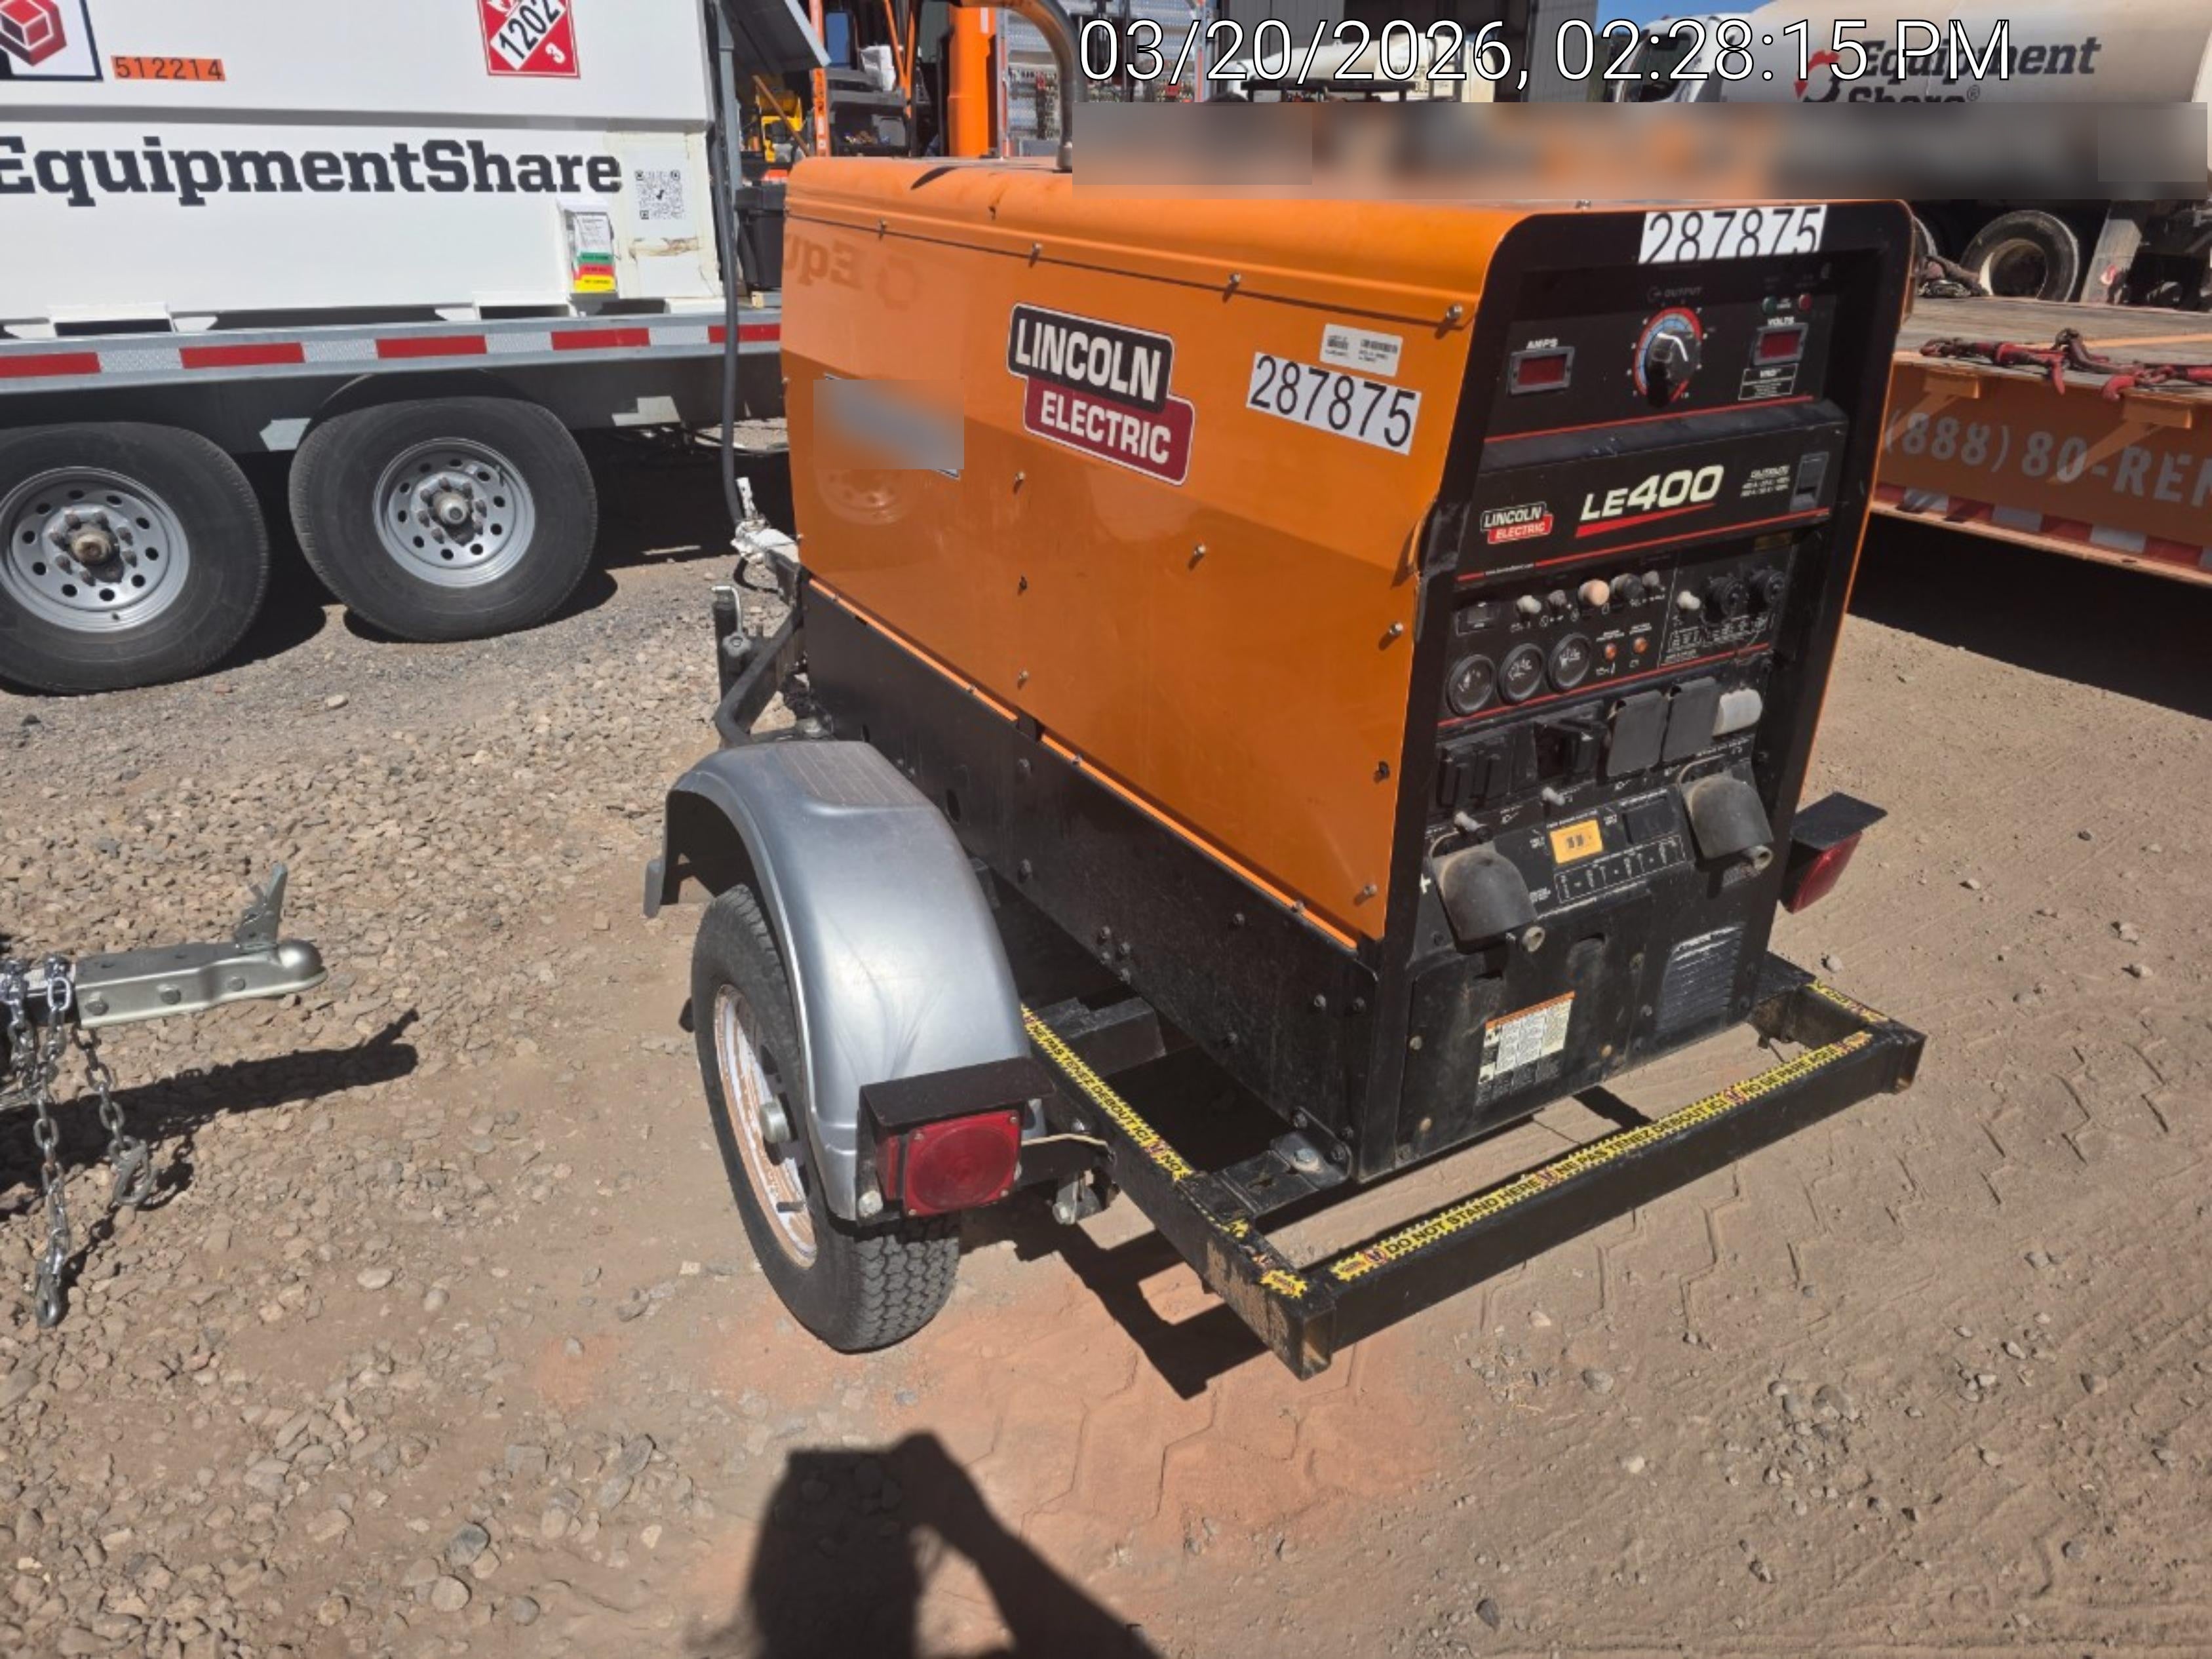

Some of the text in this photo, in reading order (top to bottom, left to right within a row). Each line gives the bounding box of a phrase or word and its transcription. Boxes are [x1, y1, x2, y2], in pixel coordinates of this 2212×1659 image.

[499, 0, 560, 59] 1202
[545, 42, 566, 64] 3
[115, 56, 222, 80] 512214
[0, 136, 623, 207] EquipmentShare
[1646, 206, 1822, 263] 287875
[1526, 338, 1559, 349] AMPS
[1768, 316, 1795, 326] VOLTS
[1015, 319, 1162, 403] LINCOLN
[1041, 391, 1172, 465] ELECTRIC
[1249, 355, 1416, 448] 287875
[1886, 409, 2009, 472] (888)
[1483, 506, 1542, 528] LINCOLN
[1580, 464, 1725, 522] LE400
[1496, 521, 1545, 539] ELECTRIC
[1384, 1177, 1542, 1255] DO NOT STAND HERE
